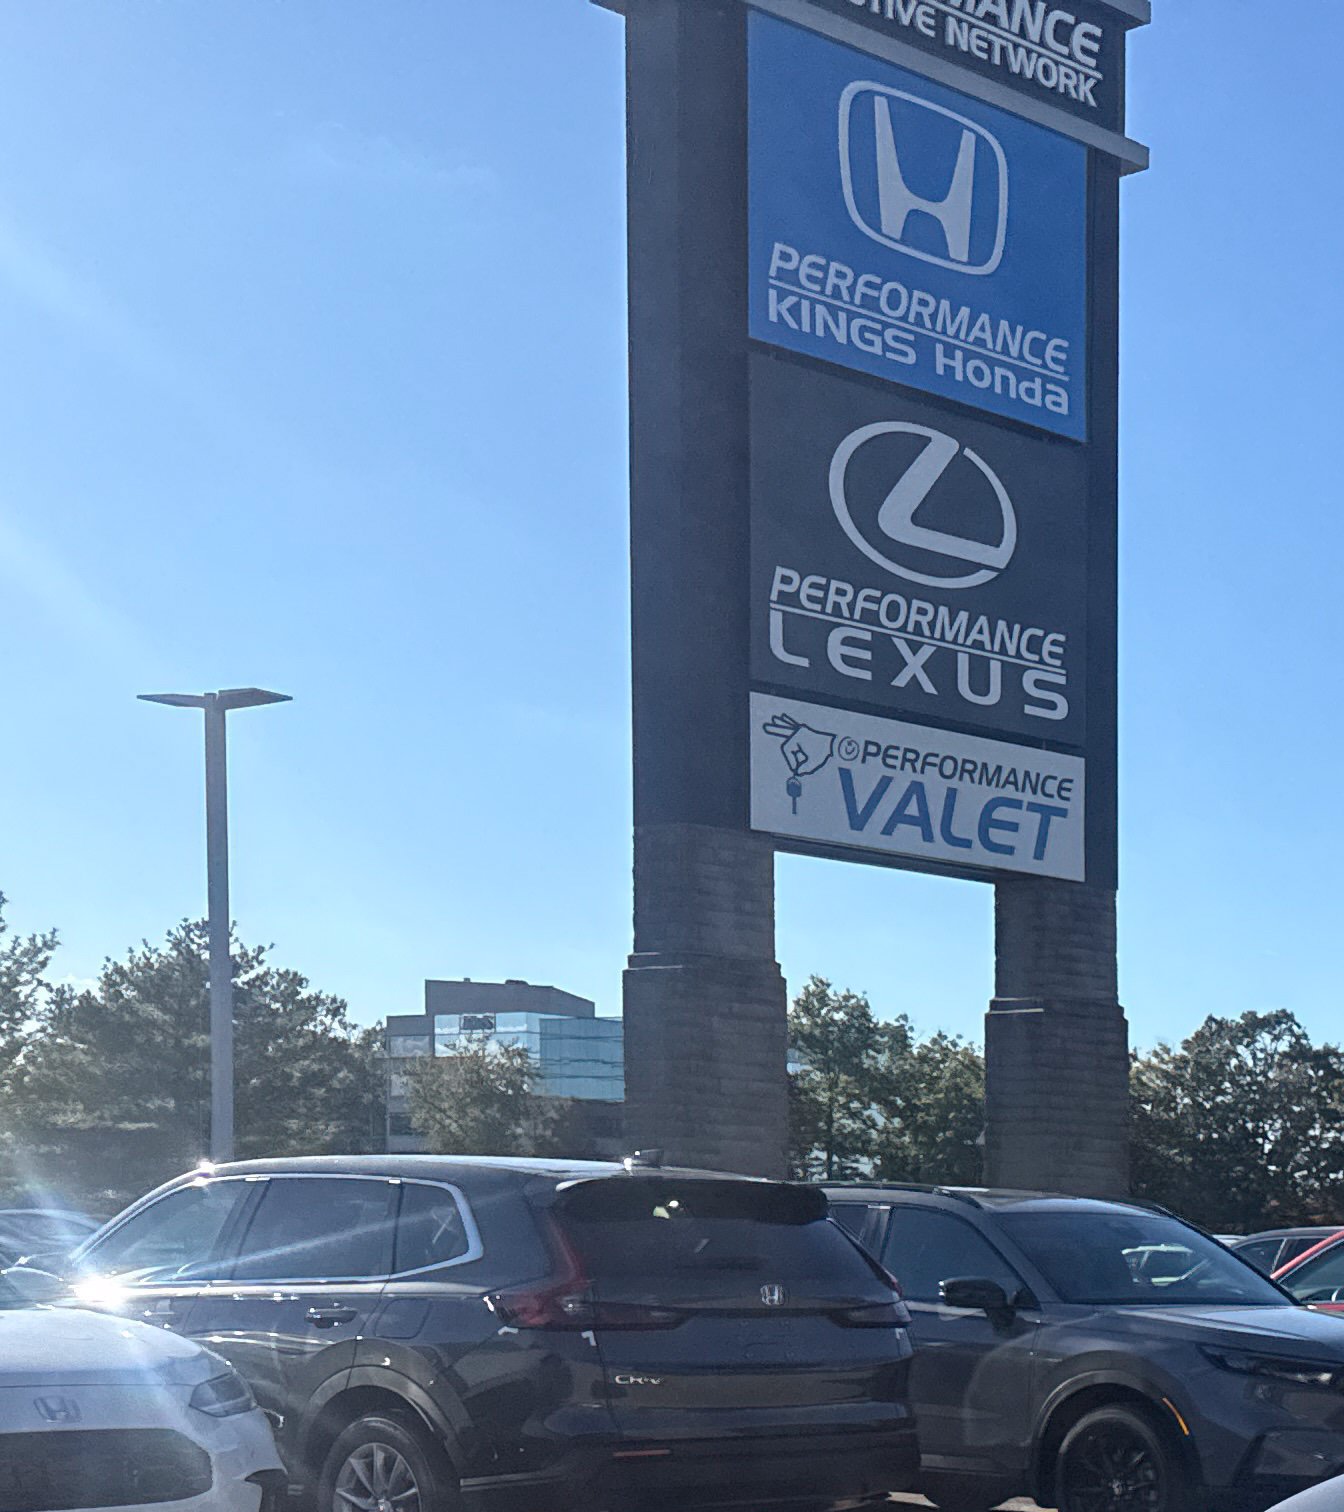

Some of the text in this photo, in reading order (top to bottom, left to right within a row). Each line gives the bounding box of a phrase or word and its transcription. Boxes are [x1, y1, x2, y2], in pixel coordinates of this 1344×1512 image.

[945, 16, 1099, 108] NETWORK
[768, 288, 1069, 416] KINGS Honda
[769, 242, 1070, 373] PERFORMANCE
[769, 565, 1067, 667] PERFORMANCE
[769, 610, 1069, 721] LEXUS
[838, 767, 1069, 861] VALET
[861, 740, 1075, 801] PERFORMANCE
